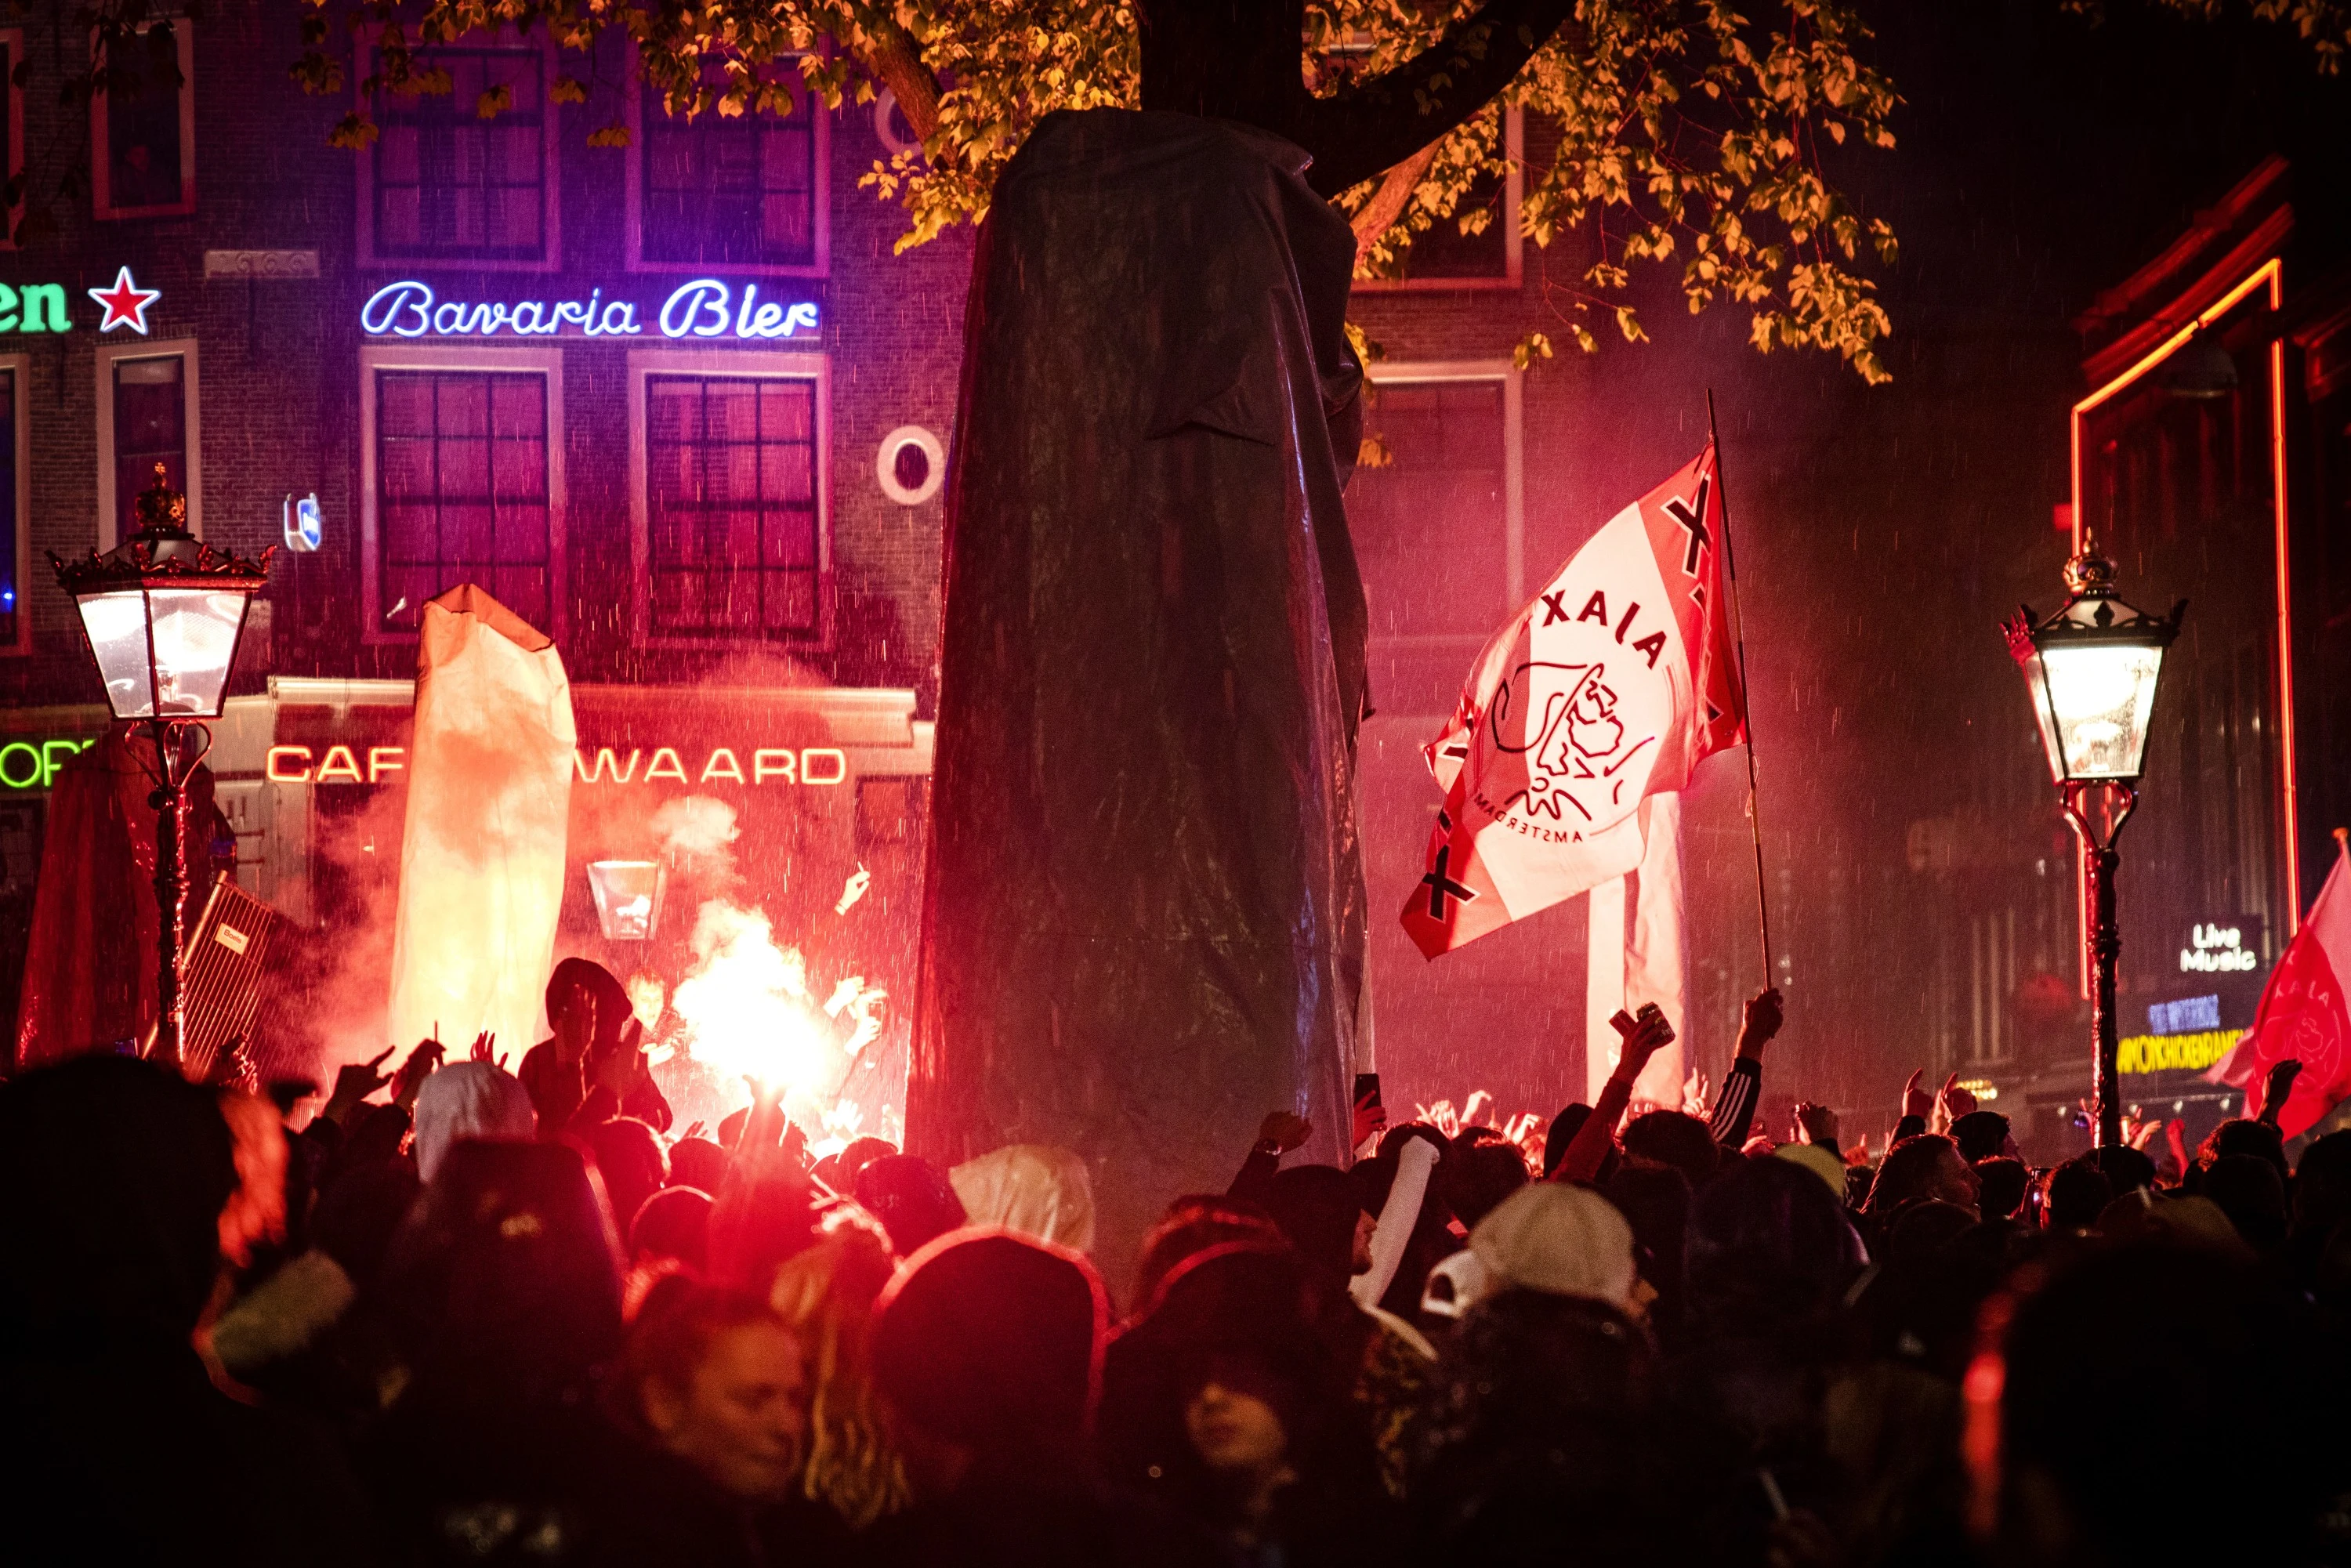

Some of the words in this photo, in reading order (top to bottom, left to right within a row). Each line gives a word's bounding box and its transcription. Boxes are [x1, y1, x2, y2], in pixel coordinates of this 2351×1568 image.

[361, 280, 641, 338] Bavaria
[659, 278, 818, 339] Bier
[0, 741, 95, 788] OP
[574, 747, 847, 785] WAARD
[224, 929, 242, 943] Boels
[2193, 922, 2241, 949] Live
[2180, 946, 2257, 972] Music
